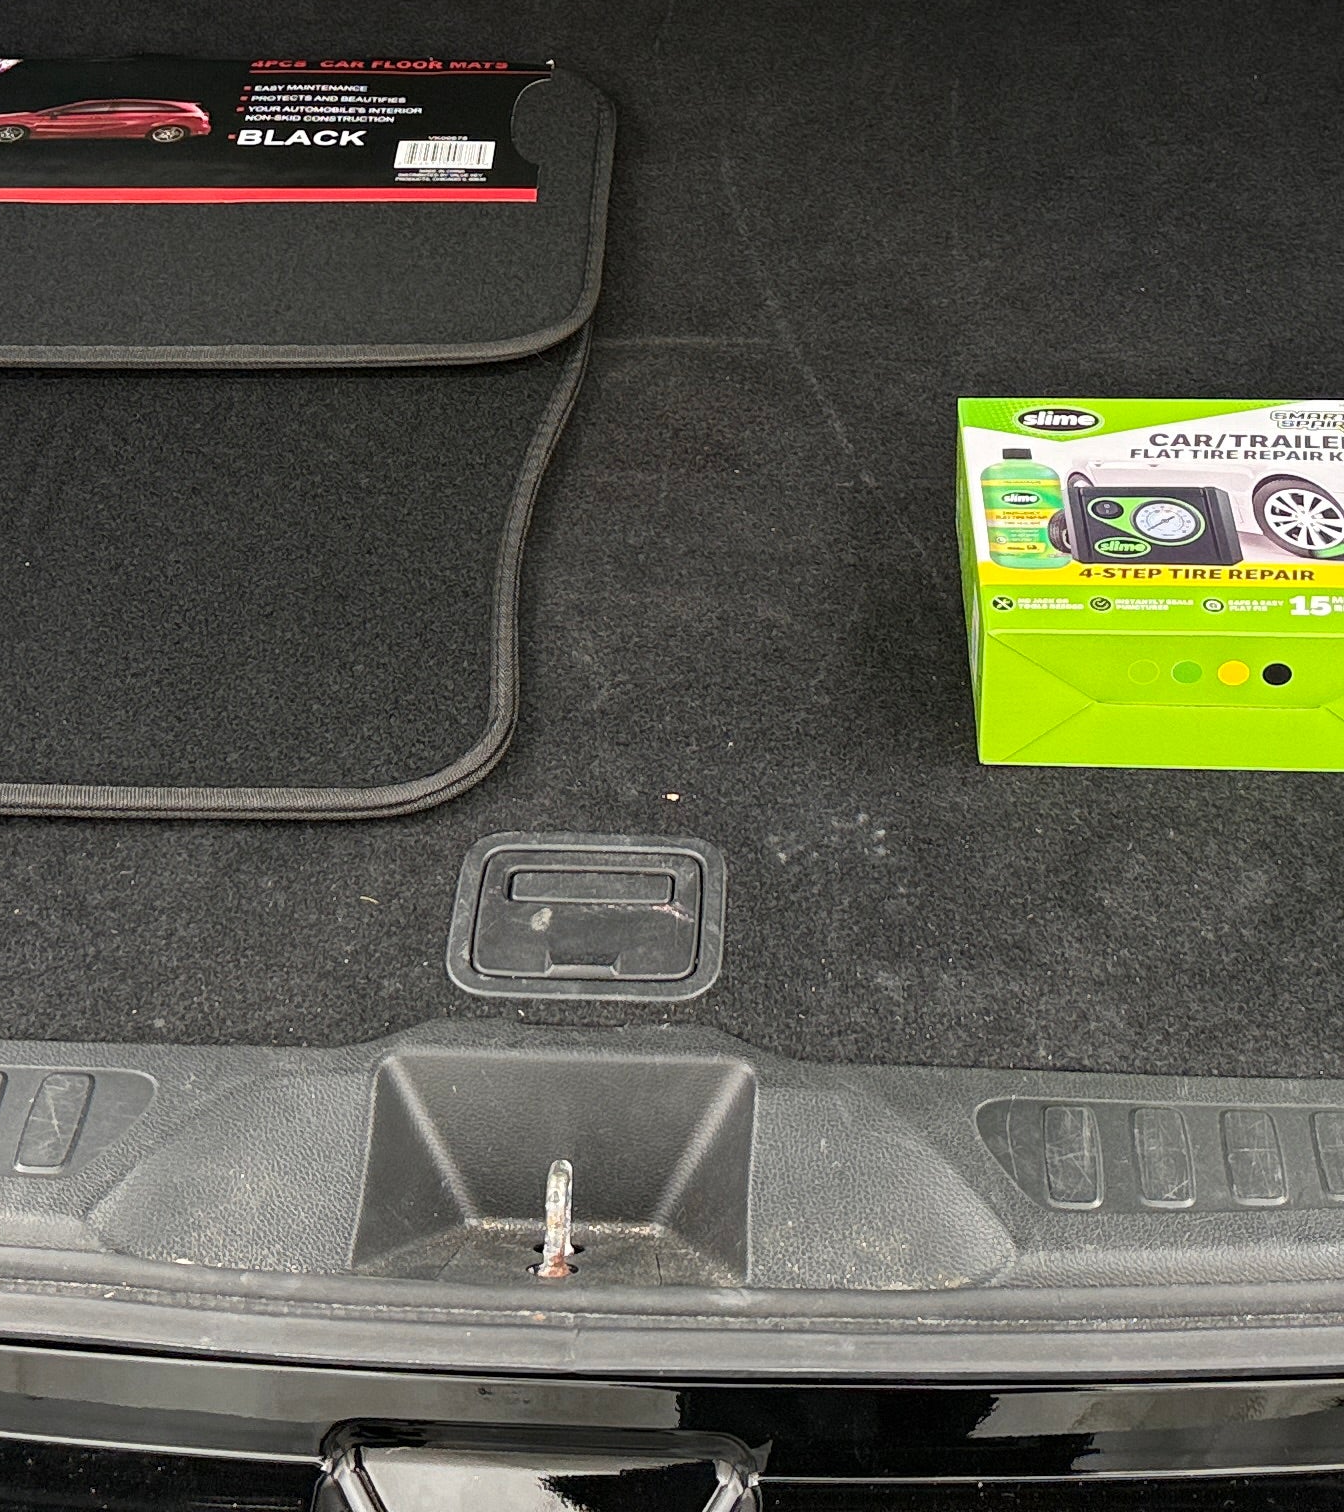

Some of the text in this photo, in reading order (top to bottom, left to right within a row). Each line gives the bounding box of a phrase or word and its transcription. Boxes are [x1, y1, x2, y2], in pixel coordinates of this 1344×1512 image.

[320, 60, 365, 68] CAR
[370, 60, 443, 69] FLOOR
[449, 61, 508, 70] MATS
[286, 84, 368, 92] MAINTENANCE
[340, 96, 406, 104] BEAUTIFIES
[248, 105, 281, 113] YOUR
[303, 115, 395, 123] CONSTRUCTION
[237, 129, 367, 146] BLACK
[1023, 411, 1095, 426] slime
[1130, 448, 1184, 459] FLAT
[1189, 449, 1239, 460] TIRE
[1244, 450, 1323, 461] REPAIR
[1100, 540, 1146, 552] slime
[1079, 568, 1315, 581] 4-STEP TIRE REPAIR
[1289, 595, 1332, 616] 15
